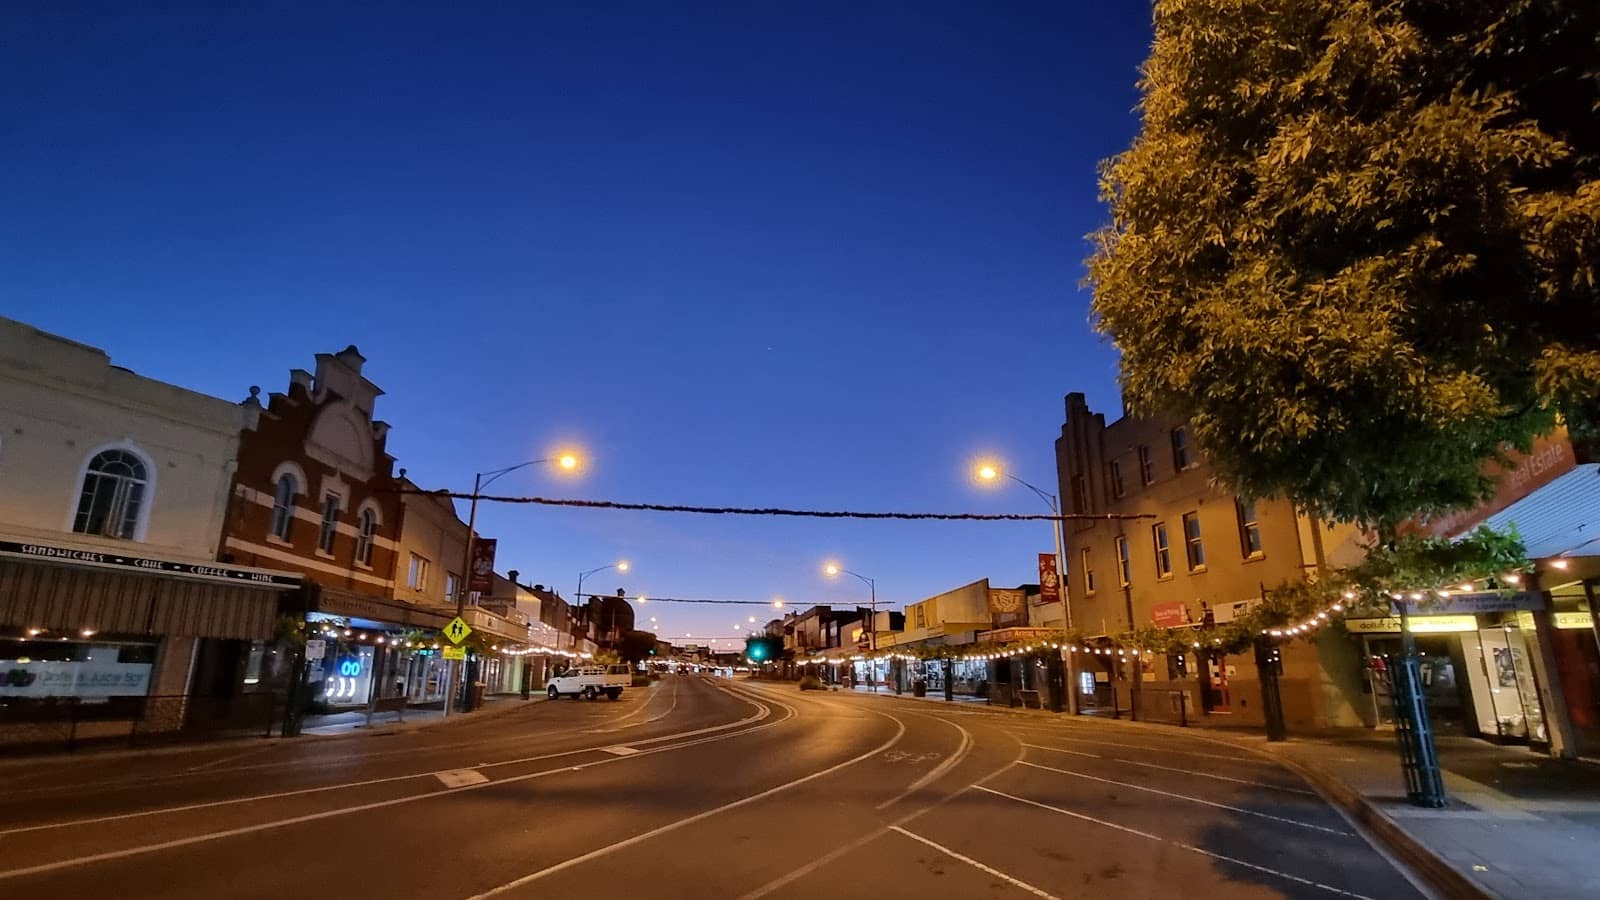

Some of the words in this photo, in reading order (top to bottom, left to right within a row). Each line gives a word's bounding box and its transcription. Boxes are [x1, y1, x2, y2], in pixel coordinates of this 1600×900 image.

[1530, 444, 1563, 476] Estate
[21, 544, 105, 562] SANDWICHES
[134, 558, 164, 571] CAKE
[190, 566, 229, 577] COFFEE
[251, 572, 274, 583] WINE
